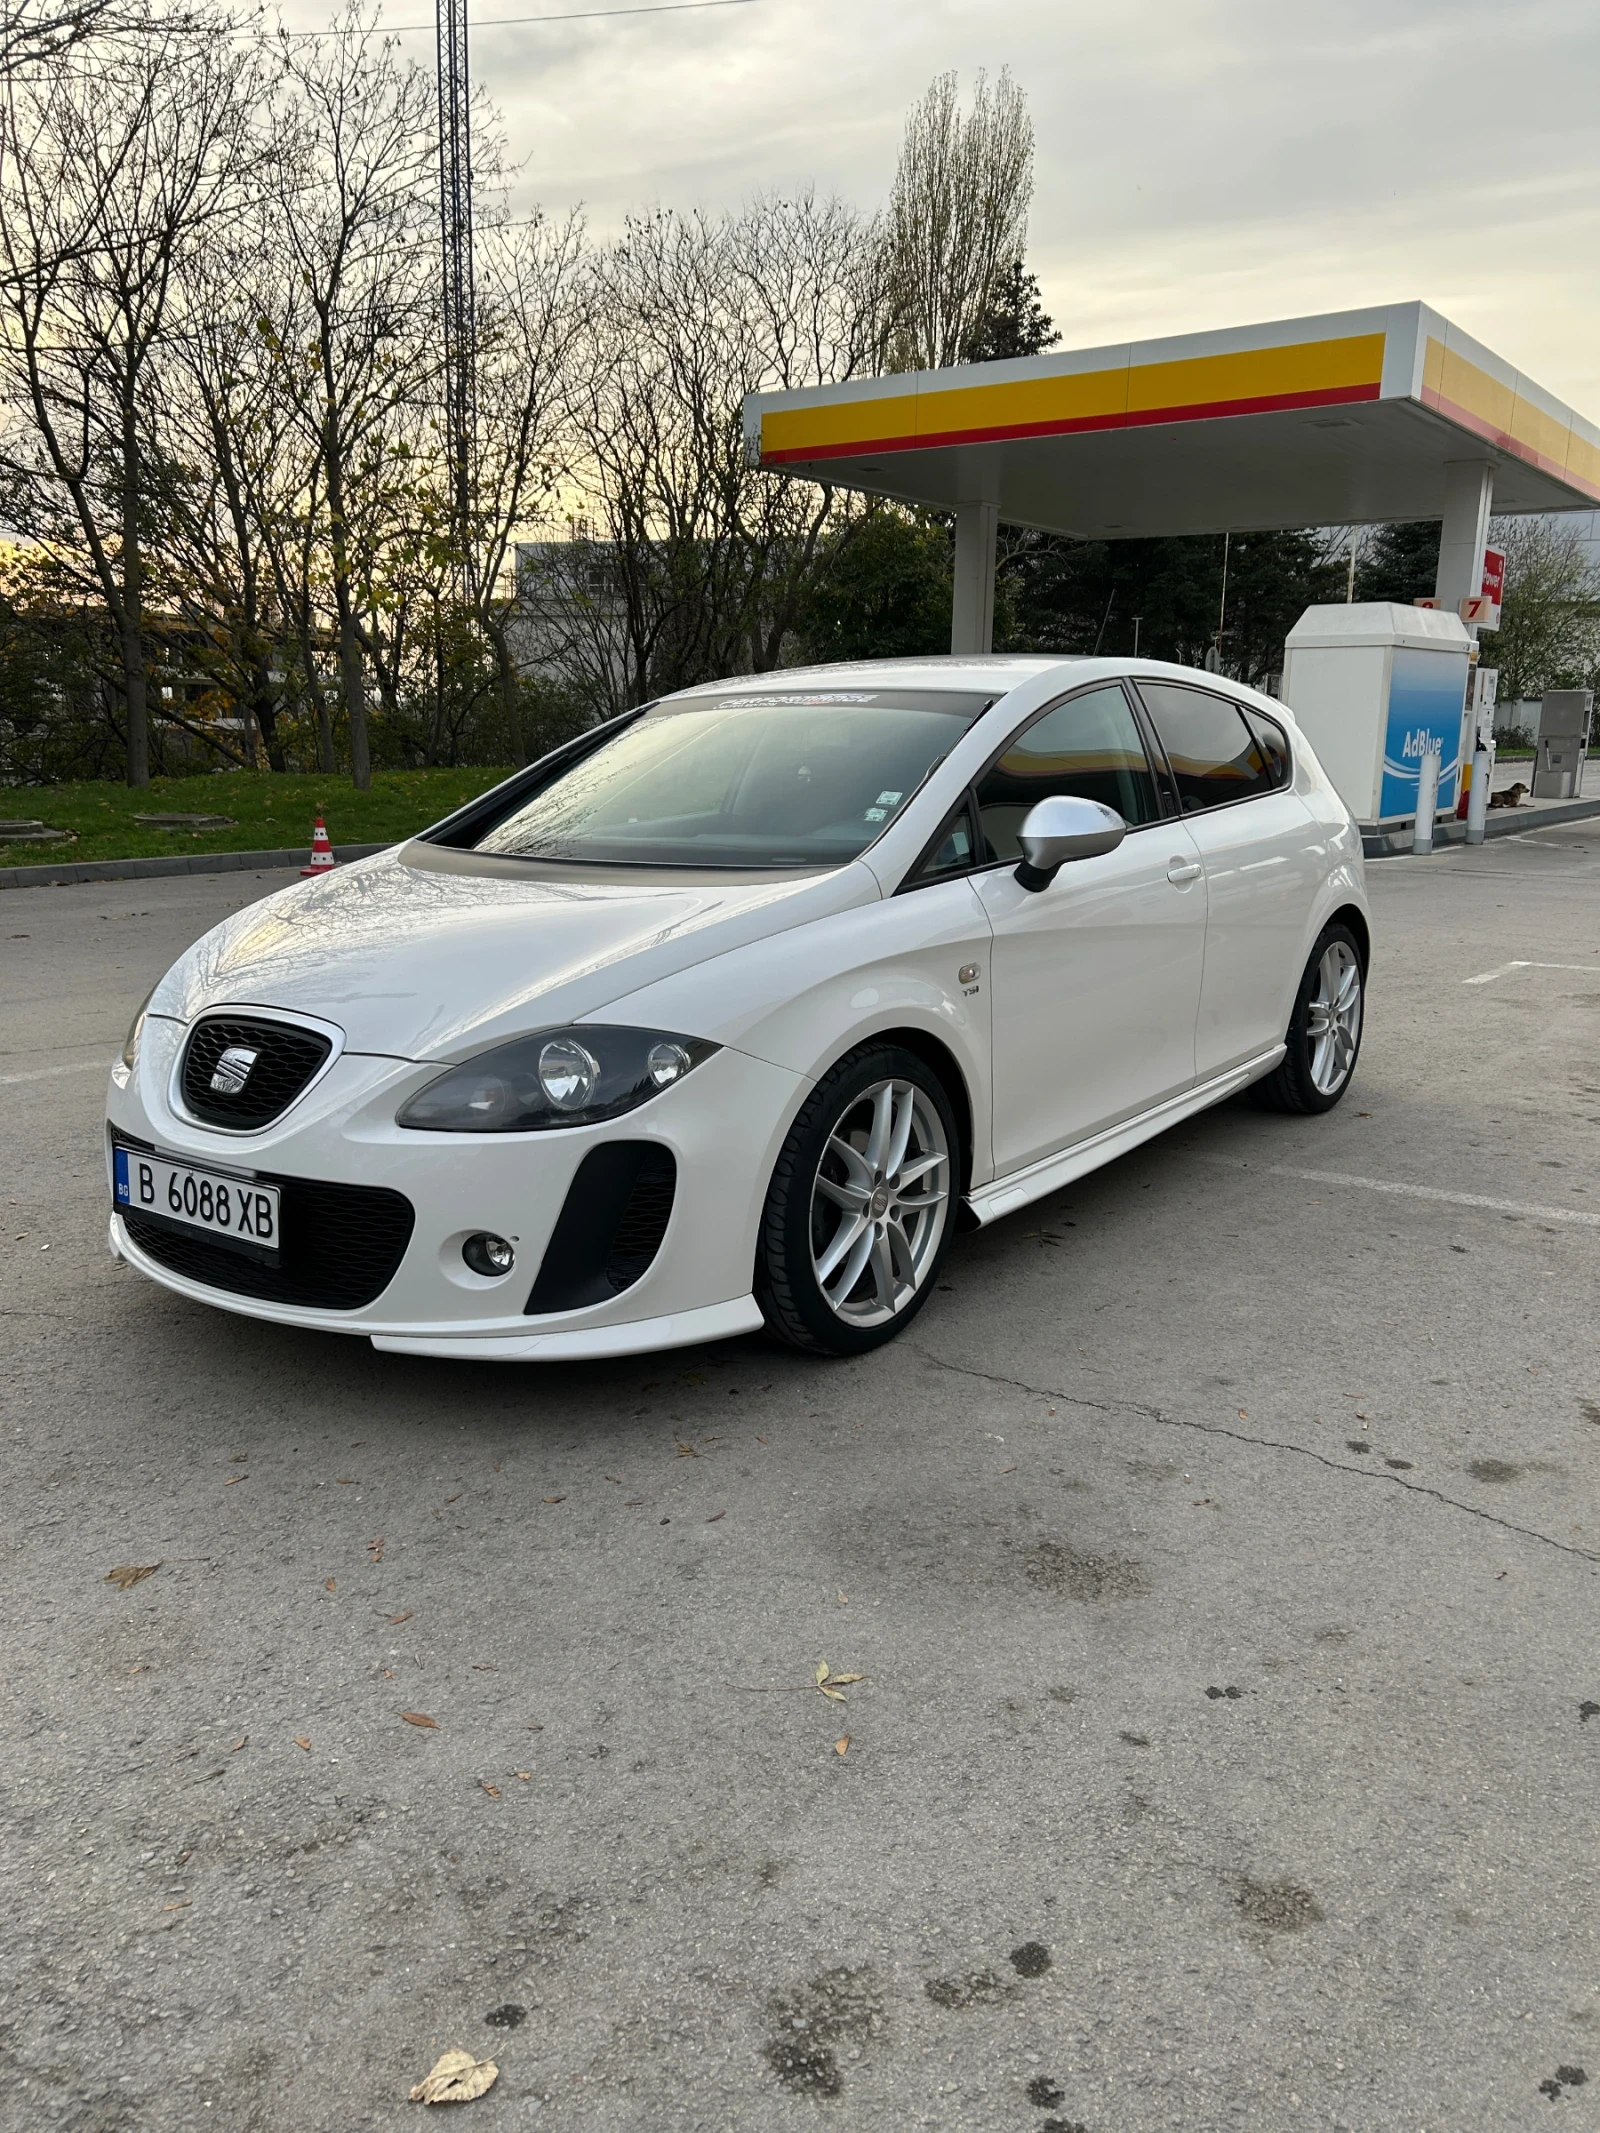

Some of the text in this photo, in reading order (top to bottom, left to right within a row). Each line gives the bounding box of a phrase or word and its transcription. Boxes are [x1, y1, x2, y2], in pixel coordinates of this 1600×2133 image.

[1468, 601, 1482, 618] 7
[1402, 728, 1442, 758] AdBlue
[118, 1183, 129, 1197] BG
[139, 1162, 274, 1239] B 6088 XB
